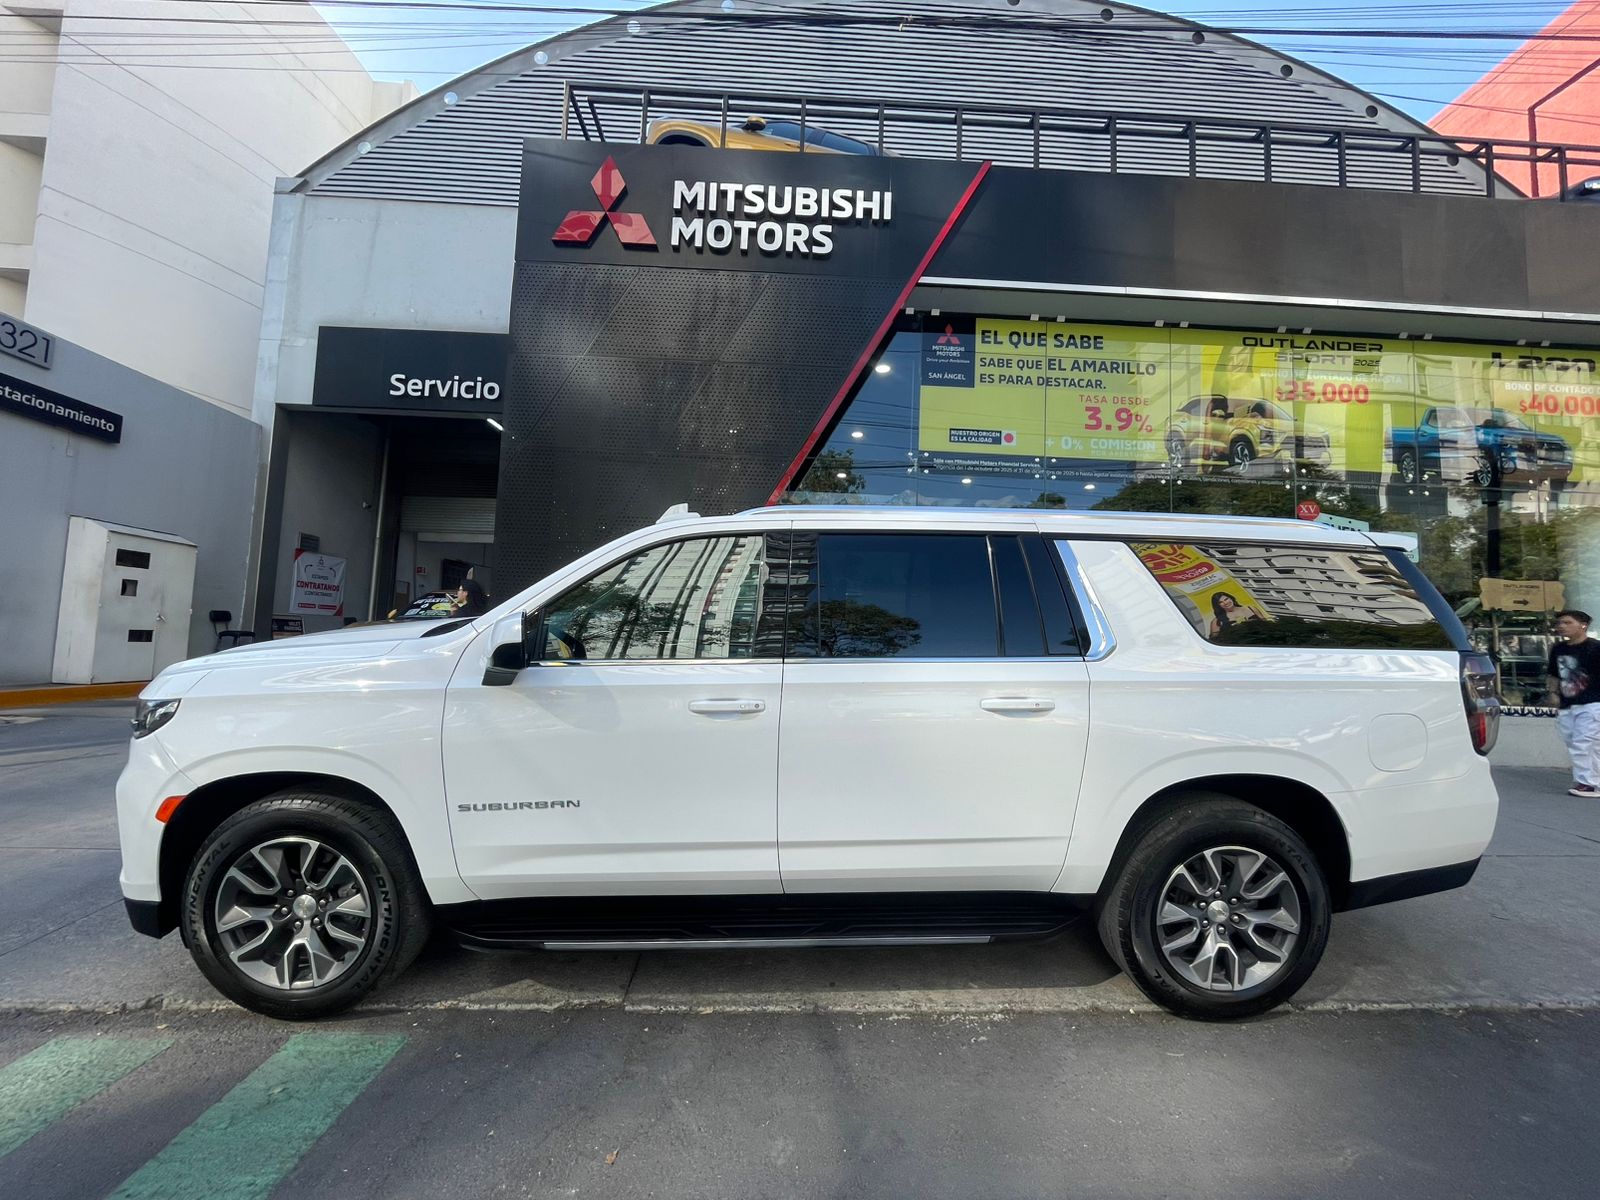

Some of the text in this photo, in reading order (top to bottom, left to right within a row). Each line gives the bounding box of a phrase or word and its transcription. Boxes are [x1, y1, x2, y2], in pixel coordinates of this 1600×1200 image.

[673, 180, 892, 220] MITSUBISHI
[671, 217, 833, 255] MOTORS
[0, 321, 50, 363] 321
[981, 330, 1104, 350] EL QUE SABE
[1242, 337, 1383, 352] OUTLANDER
[1275, 352, 1351, 364] SPORT
[980, 358, 1157, 376] SABE QUE EL AMARILLO
[943, 372, 966, 380] ÁNGEL
[980, 374, 1107, 390] ES PARA DESTACAR.
[389, 373, 500, 399] Servicio
[1505, 382, 1531, 391] BONO
[1549, 384, 1594, 393] CONTADO
[1079, 395, 1150, 406] TASA DESDE
[1085, 406, 1153, 432] 3.9%
[1062, 437, 1083, 450] 0%
[1300, 505, 1316, 513] XV
[296, 581, 340, 592] CONTRATANDO
[457, 800, 581, 812] SUBURBAN
[188, 841, 231, 946] NTINENTAL
